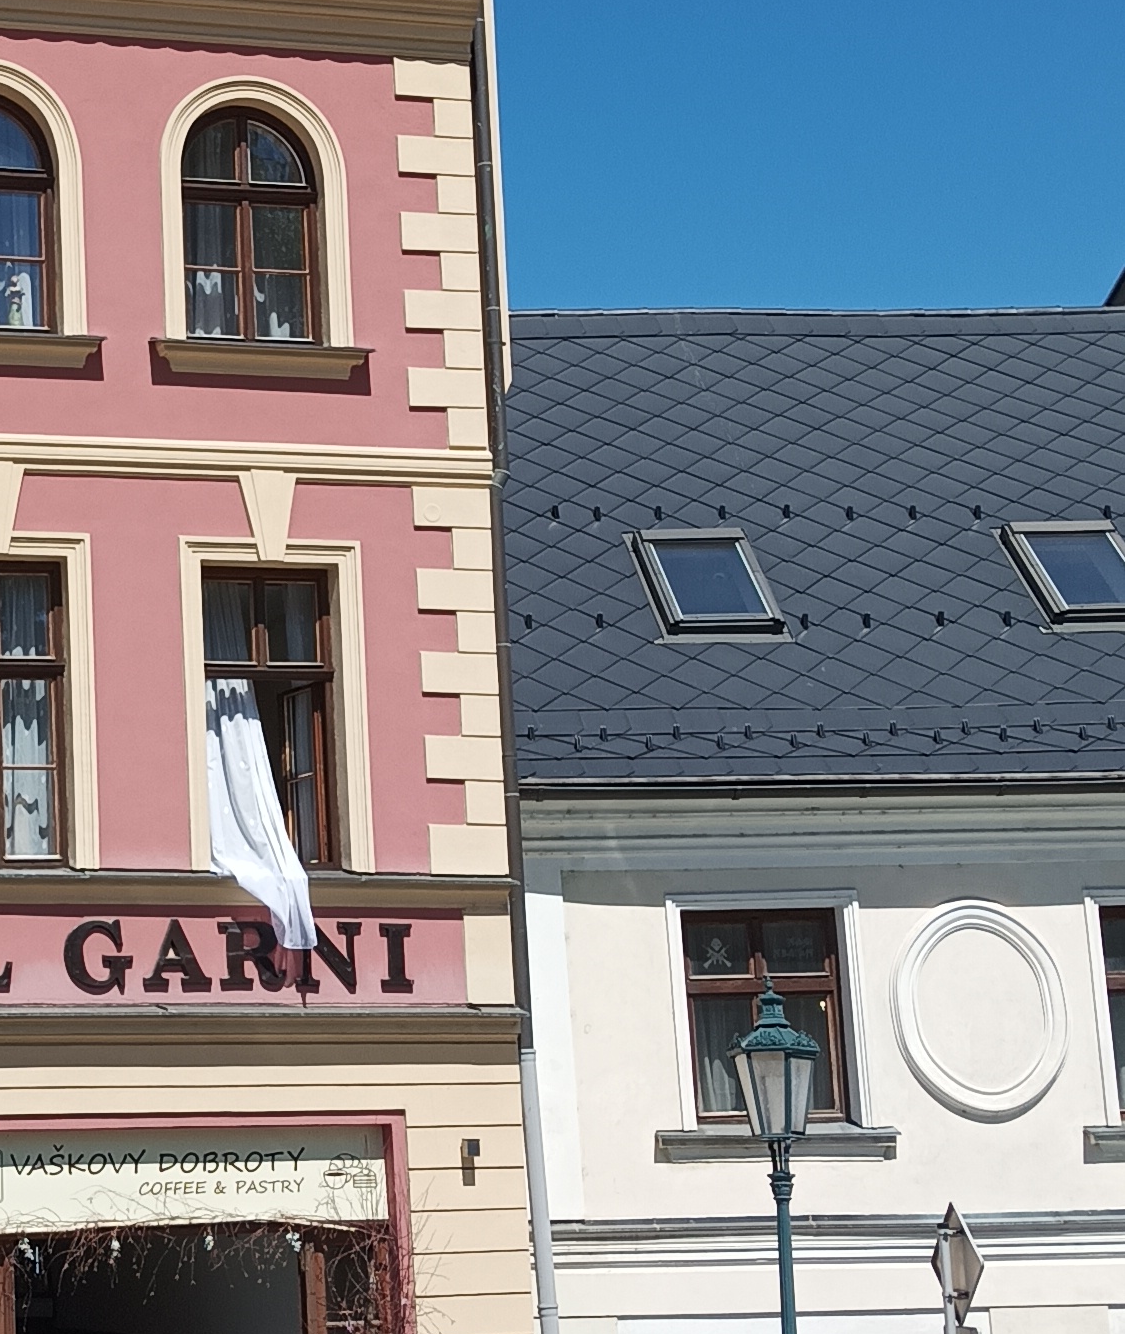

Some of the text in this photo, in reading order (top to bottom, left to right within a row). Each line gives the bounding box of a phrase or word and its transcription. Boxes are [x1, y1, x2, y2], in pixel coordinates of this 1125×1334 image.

[63, 918, 415, 995] GARNI
[9, 1144, 306, 1176] VAŠKOVY DOBROTY
[138, 1177, 305, 1196] COFFEE & PASTRY
